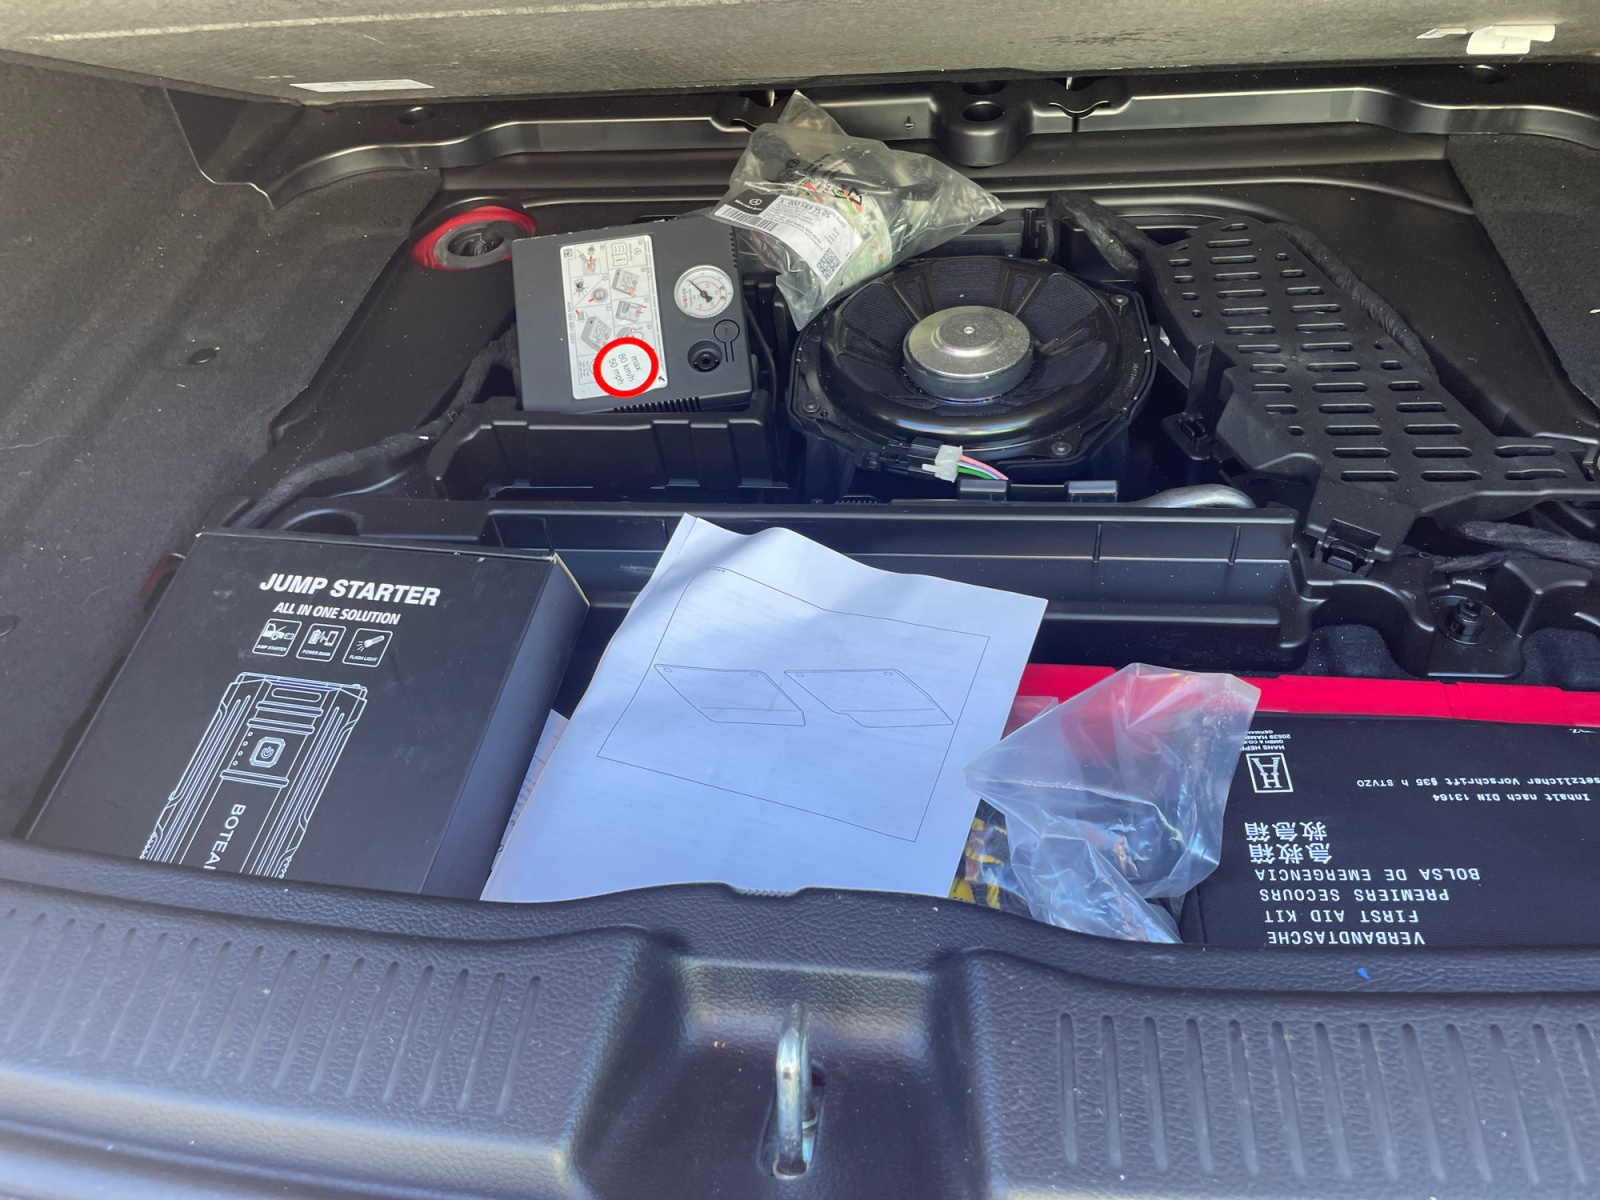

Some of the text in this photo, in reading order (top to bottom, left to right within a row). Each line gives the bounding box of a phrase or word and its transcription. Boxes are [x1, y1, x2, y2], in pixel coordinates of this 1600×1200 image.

[618, 352, 636, 382] 80 km/h
[630, 355, 642, 372] max
[608, 358, 625, 386] 50 mph
[259, 572, 441, 607] JUMP STARTER
[273, 601, 402, 625] ALL IN ONE SOLUTION
[1400, 779, 1409, 787] h
[1444, 777, 1521, 786] Vorschrift
[1432, 793, 1591, 802] Inhalt nach DIN 13164
[1244, 821, 1328, 843] 救急箱
[1248, 843, 1333, 865] 急救箱
[1254, 867, 1481, 882] BOLSA DE EMERGENCIA
[1259, 888, 1450, 902] PREMIERS SECOURS
[1264, 909, 1419, 924] FIRST AID KIT
[1266, 930, 1426, 946] VERBANDTASCHE
